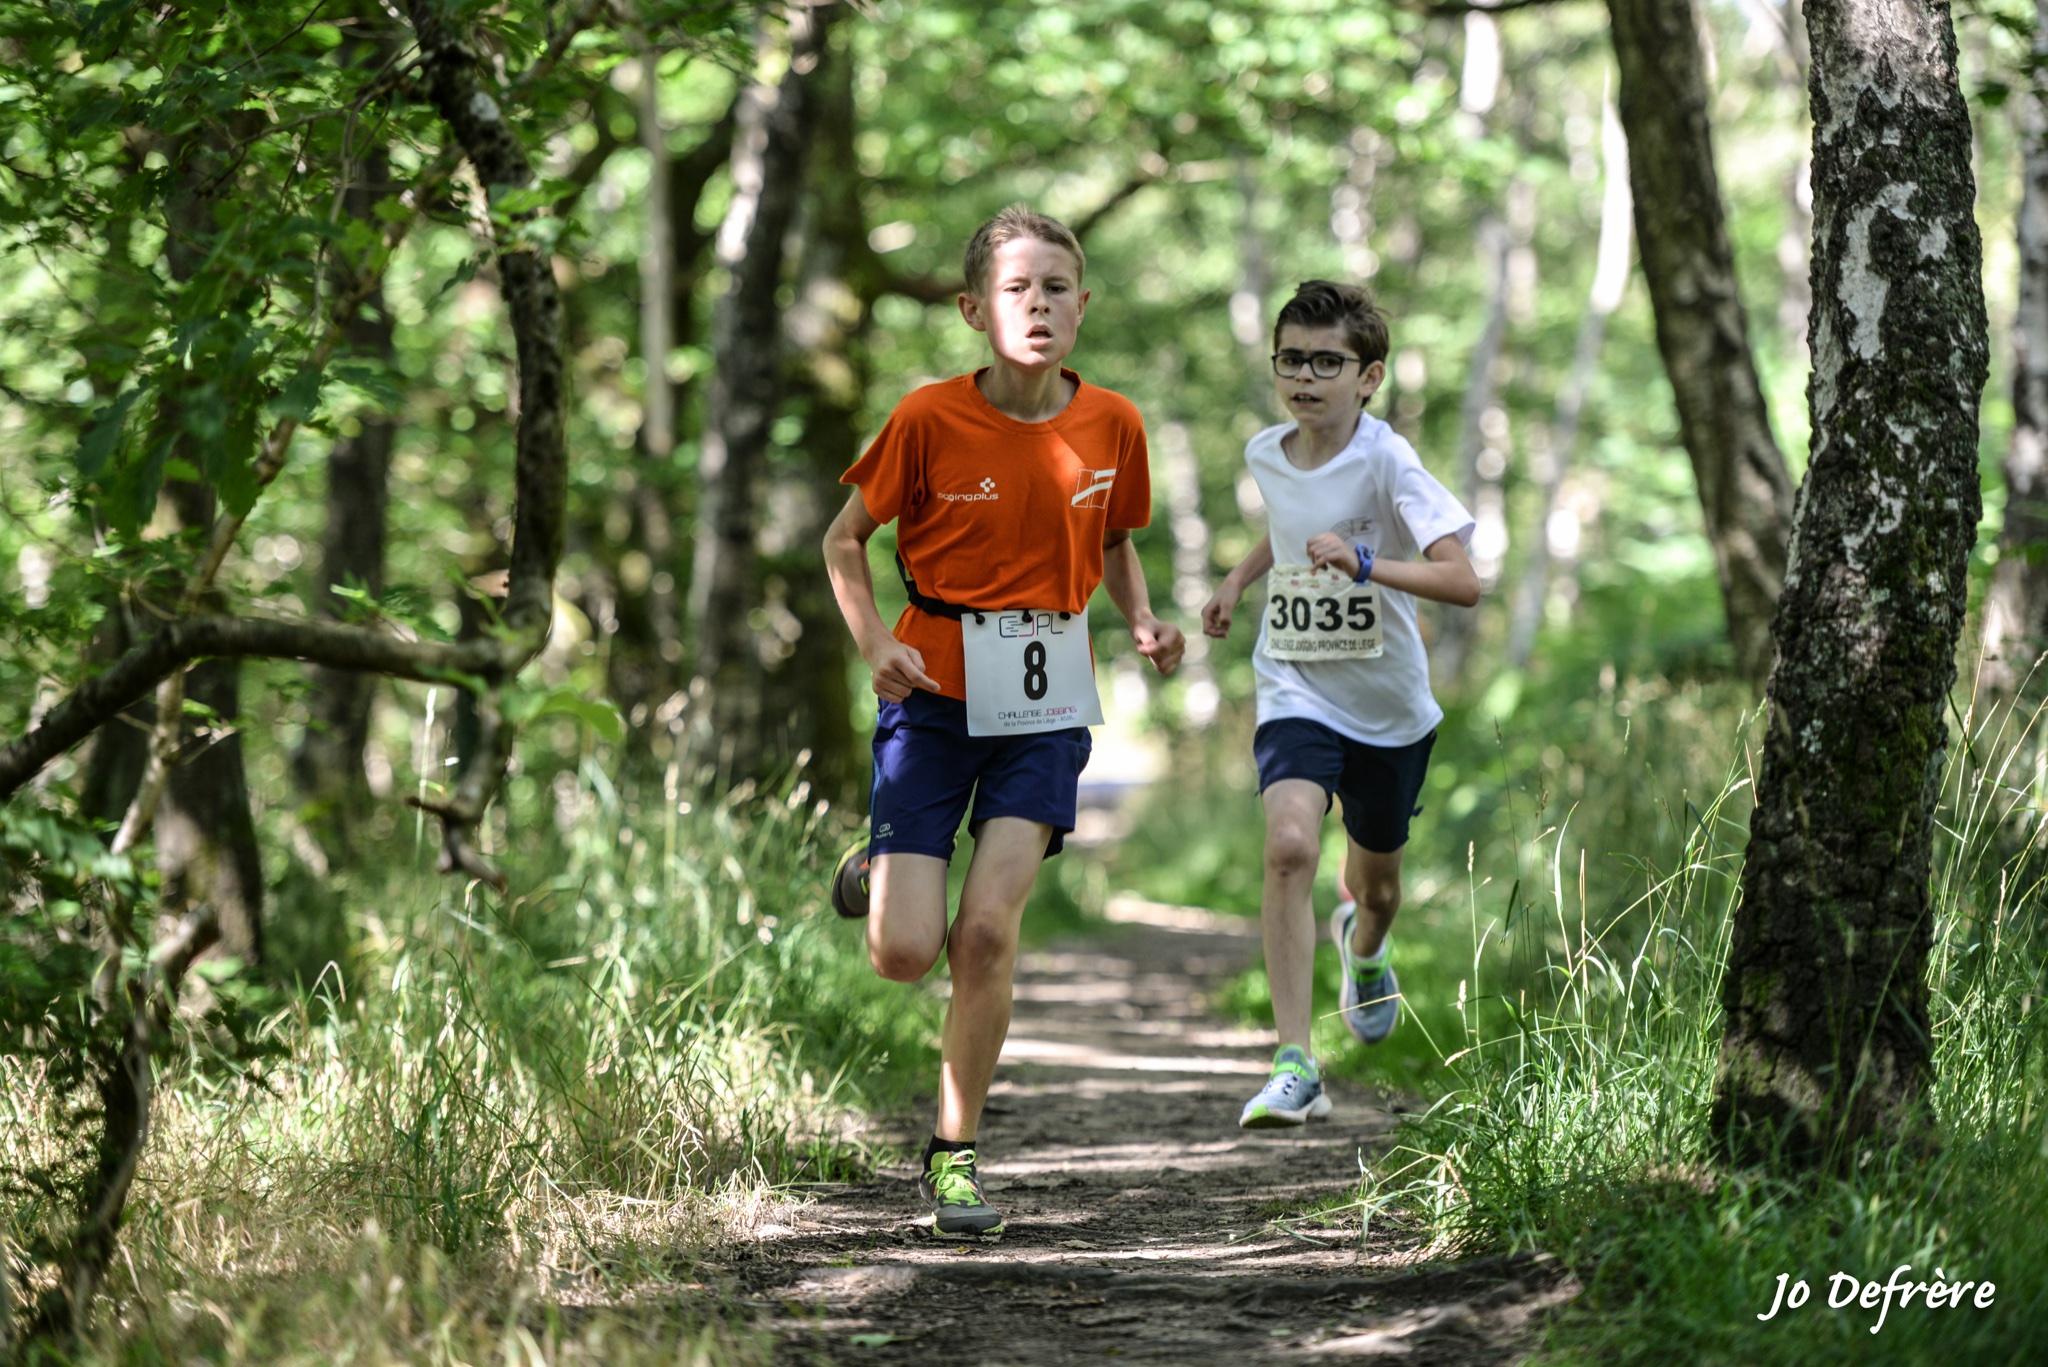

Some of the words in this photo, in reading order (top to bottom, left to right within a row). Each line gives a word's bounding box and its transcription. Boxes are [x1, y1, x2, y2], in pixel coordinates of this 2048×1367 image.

[1270, 594, 1376, 632] 3035
[1318, 639, 1348, 652] PROVINCE
[1349, 639, 1357, 651] DE
[1023, 641, 1048, 700] 8
